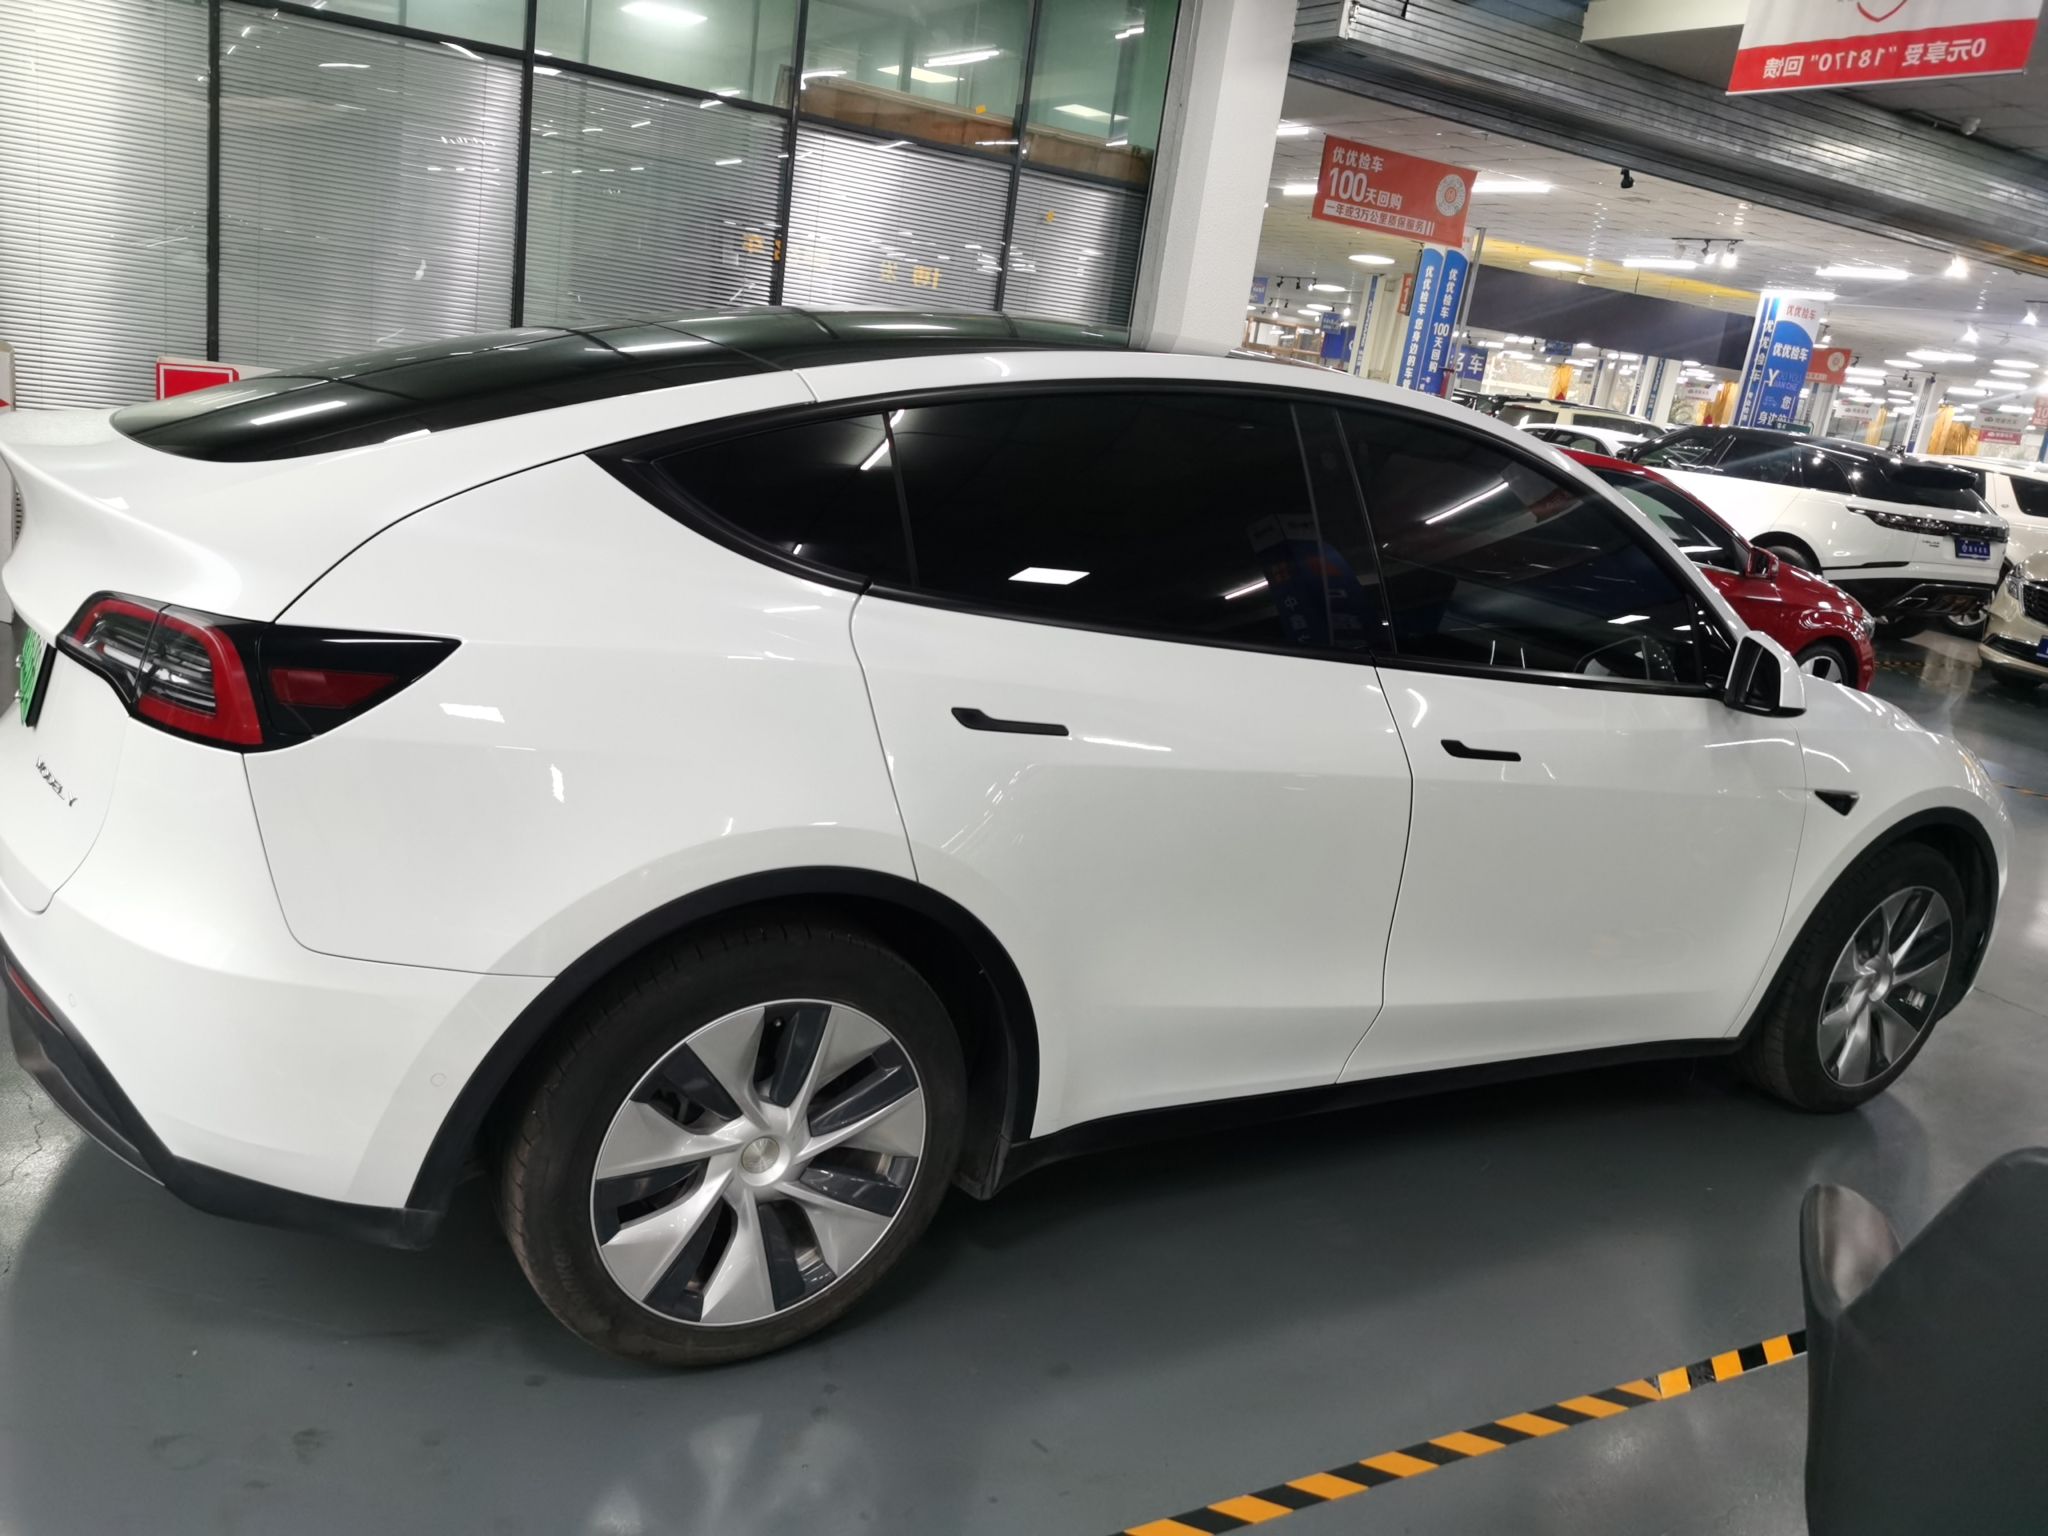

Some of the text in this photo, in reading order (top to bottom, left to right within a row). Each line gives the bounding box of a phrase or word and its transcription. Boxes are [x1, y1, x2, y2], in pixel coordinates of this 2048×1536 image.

[1333, 146, 1385, 173] 优优检车
[1329, 167, 1403, 211] 100天回购
[1417, 265, 1435, 316] 优优检车
[1440, 268, 1459, 319] 优优检车
[1786, 304, 1817, 321] 优优检车
[1772, 342, 1809, 362] 优优检车
